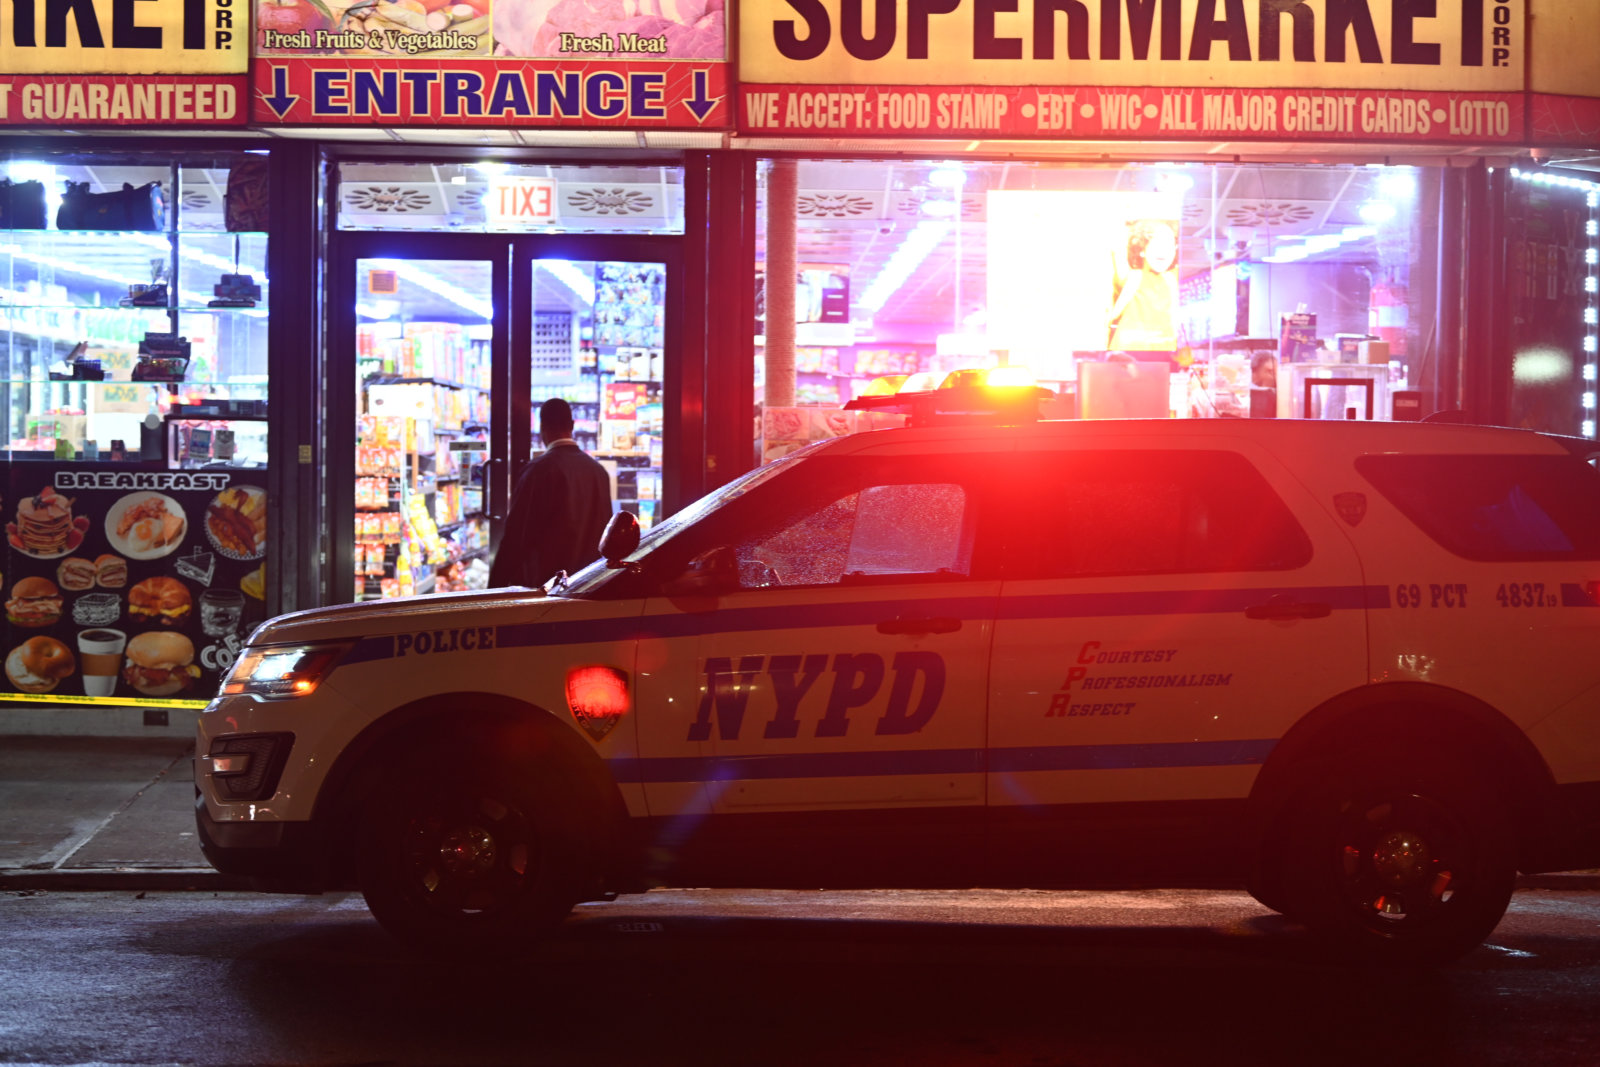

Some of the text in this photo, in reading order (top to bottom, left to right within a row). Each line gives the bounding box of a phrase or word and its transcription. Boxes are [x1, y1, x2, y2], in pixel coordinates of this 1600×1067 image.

[264, 29, 478, 54] Fresh Fruits & Vegetables
[560, 33, 668, 53] Fresh Meat
[1492, 0, 1510, 67] ORP.
[22, 83, 236, 120] GUARANTEED
[311, 68, 667, 119] ENTRANCE
[746, 92, 779, 128] WE
[785, 92, 871, 129] ACCEPT:
[877, 93, 930, 129] FOOD
[936, 94, 1008, 130] STAMP
[1203, 94, 1277, 132] MAJOR
[1283, 95, 1357, 134] CREDIT
[55, 472, 230, 490] BREAKFAST
[1396, 584, 1421, 608] 69
[1429, 584, 1468, 608] PCT
[201, 633, 247, 669] COF
[396, 627, 494, 657] POLICE
[1076, 641, 1178, 665] COURTESY
[1059, 667, 1233, 690] PROFESSIONALISM
[686, 652, 946, 742] NYPD
[1044, 693, 1136, 717] RESPECT
